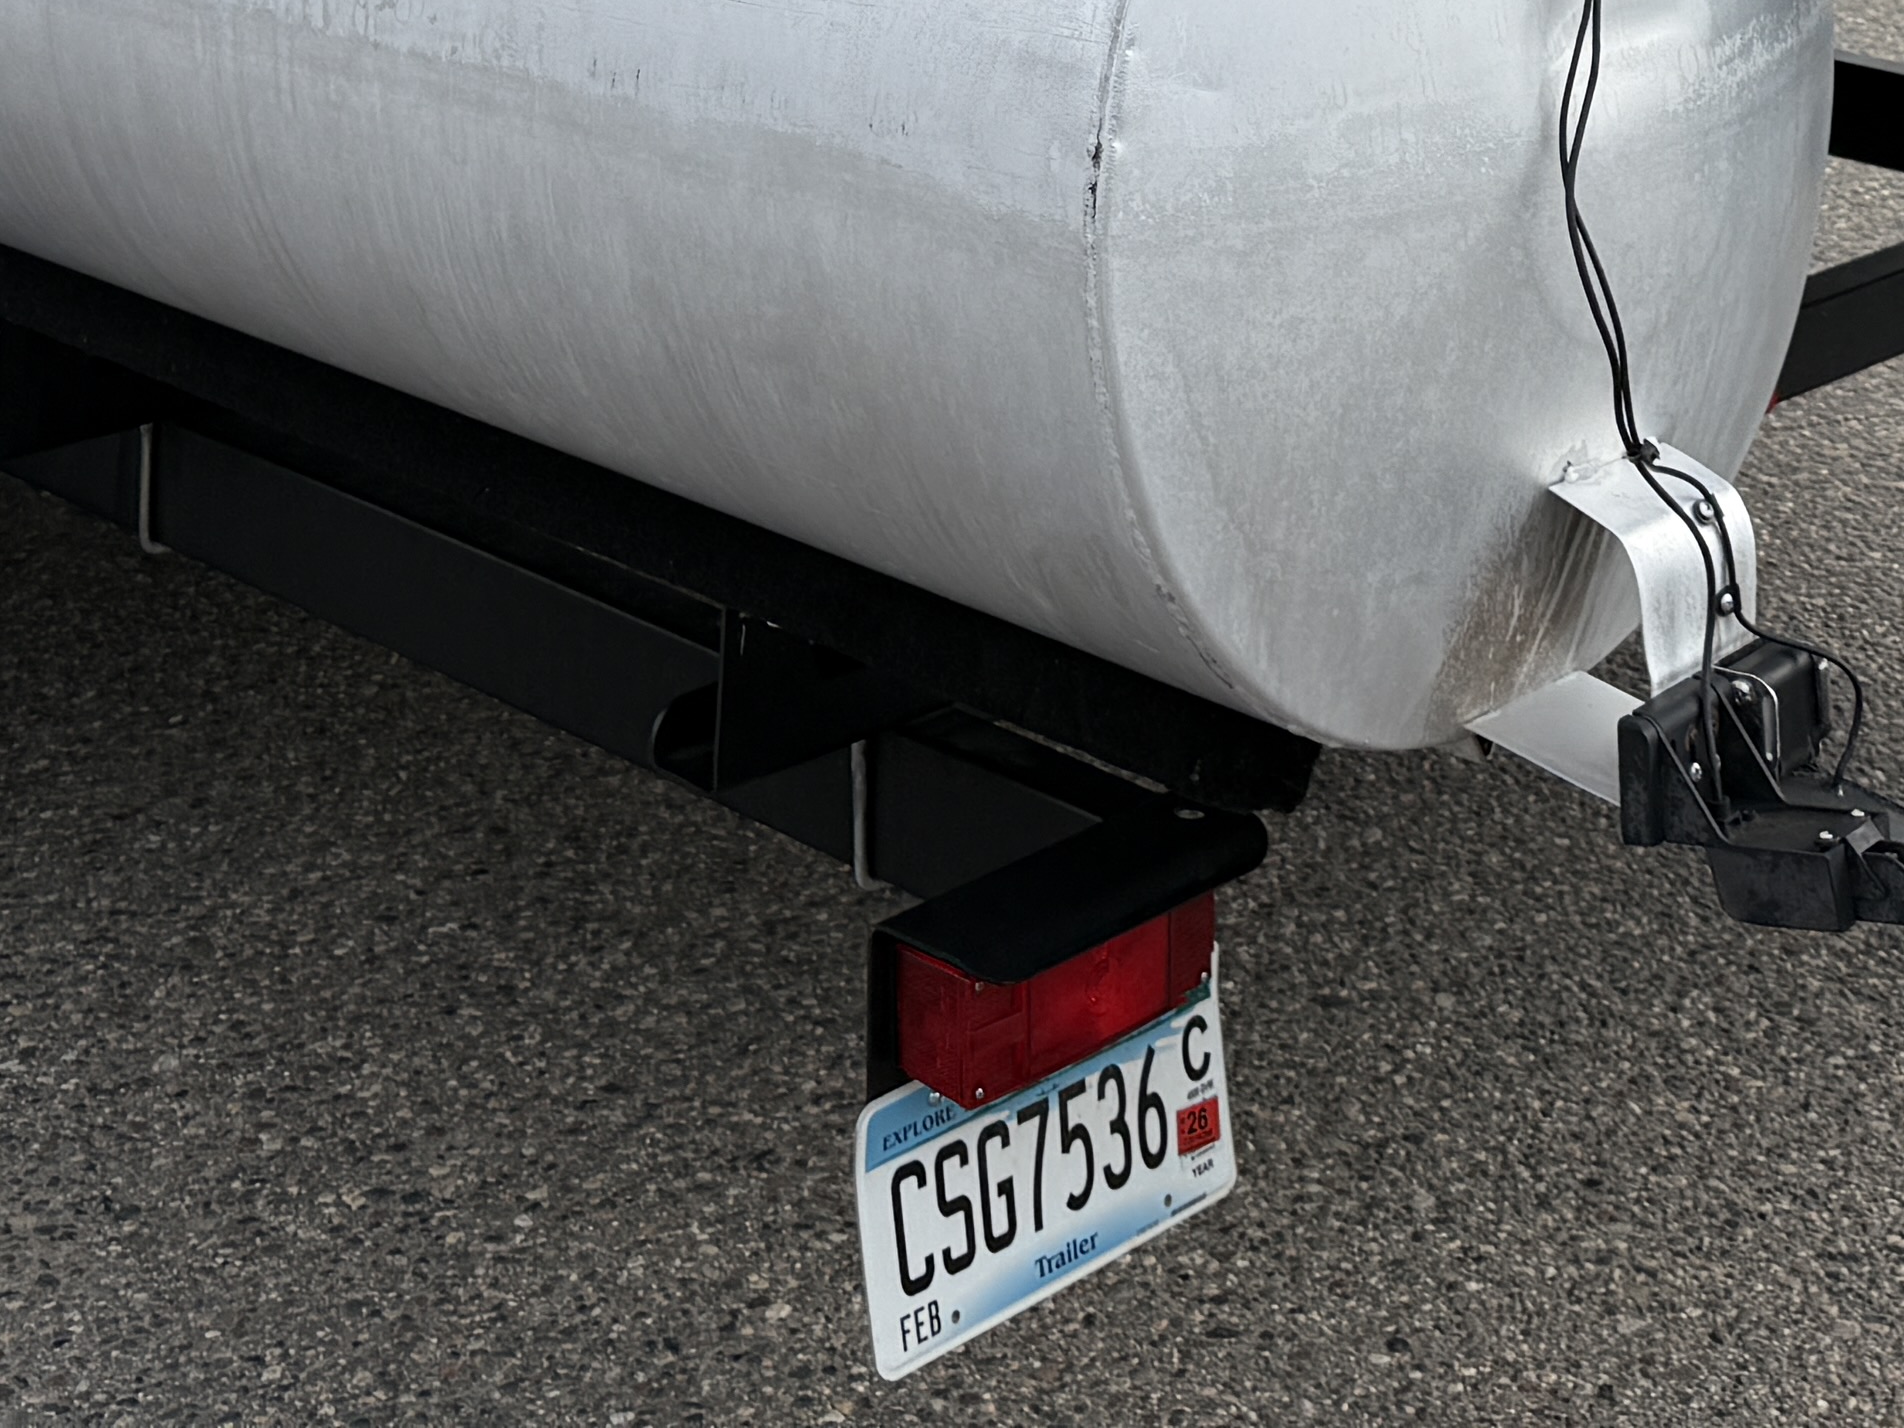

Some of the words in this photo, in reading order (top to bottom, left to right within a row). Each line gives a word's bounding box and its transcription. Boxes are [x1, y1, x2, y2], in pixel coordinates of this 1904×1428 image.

[1182, 1015, 1211, 1082] C
[882, 1105, 958, 1152] EXPLORE
[1187, 1107, 1208, 1135] 26
[890, 1044, 1168, 1297] CSG7536
[1034, 1231, 1099, 1279] Trailer
[900, 1299, 942, 1353] FEB
